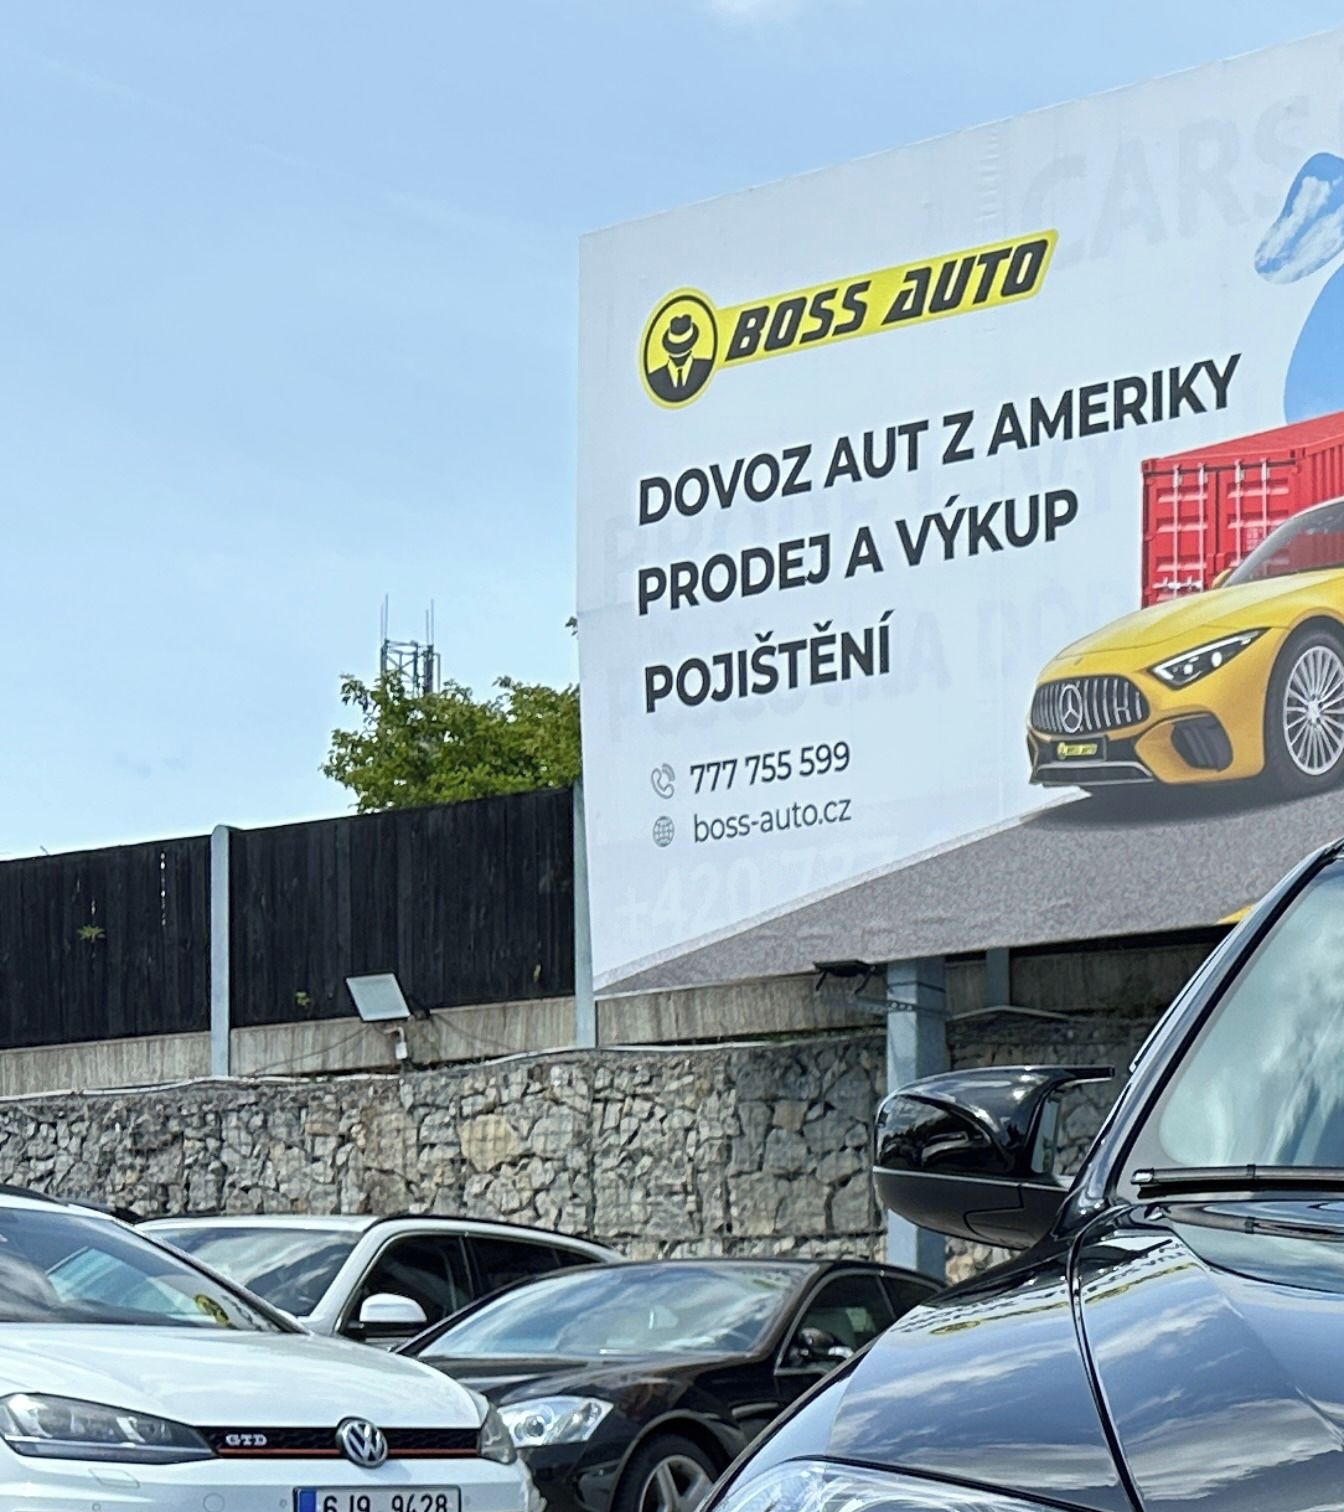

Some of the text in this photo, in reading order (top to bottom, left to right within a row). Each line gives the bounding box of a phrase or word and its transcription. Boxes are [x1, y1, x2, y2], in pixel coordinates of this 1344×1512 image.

[725, 239, 1048, 361] BOSS AUTO
[639, 353, 1242, 525] DOVOZ AUT Z AMERIKY
[638, 489, 1079, 616] PRODEJ A VÝKUP
[645, 609, 895, 713] POJIŠTĚNÍ
[690, 741, 850, 794] 777 755 599
[693, 798, 852, 843] boss-auto.cz
[225, 1433, 268, 1446] GTD
